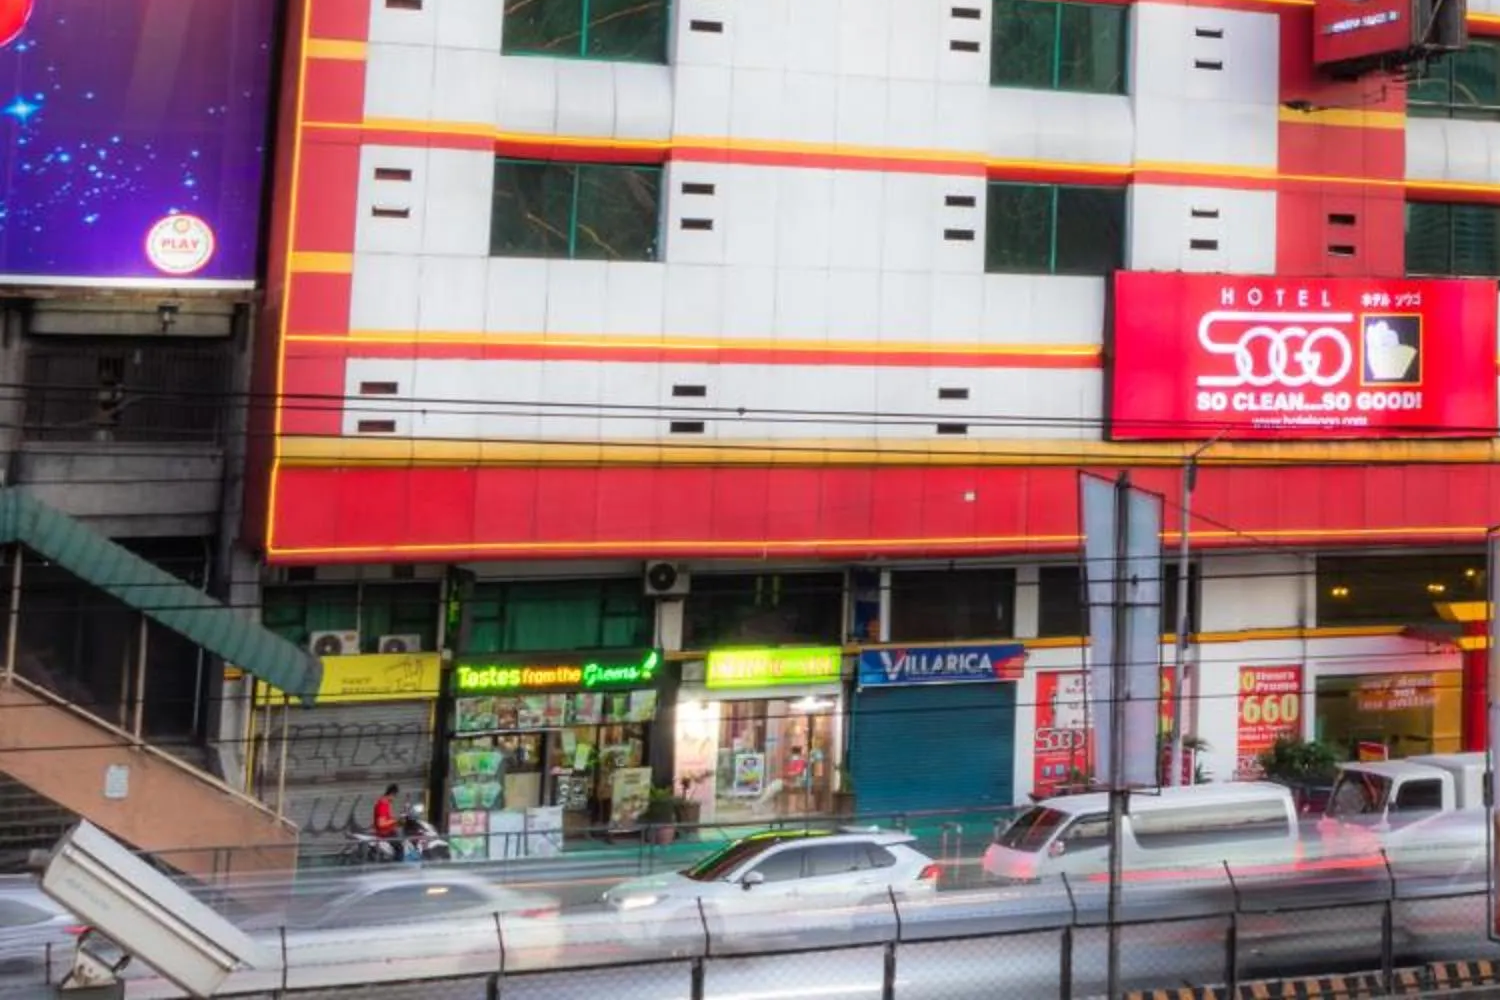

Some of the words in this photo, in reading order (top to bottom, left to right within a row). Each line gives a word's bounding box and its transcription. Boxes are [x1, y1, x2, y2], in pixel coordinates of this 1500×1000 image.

[161, 237, 200, 250] PLAY
[1220, 287, 1332, 307] HOTEL
[1196, 311, 1354, 388] SOGO
[1197, 391, 1227, 412] SO
[1356, 391, 1424, 411] GOOD!
[880, 650, 993, 680] VILLARICA
[457, 666, 521, 688] Tastes
